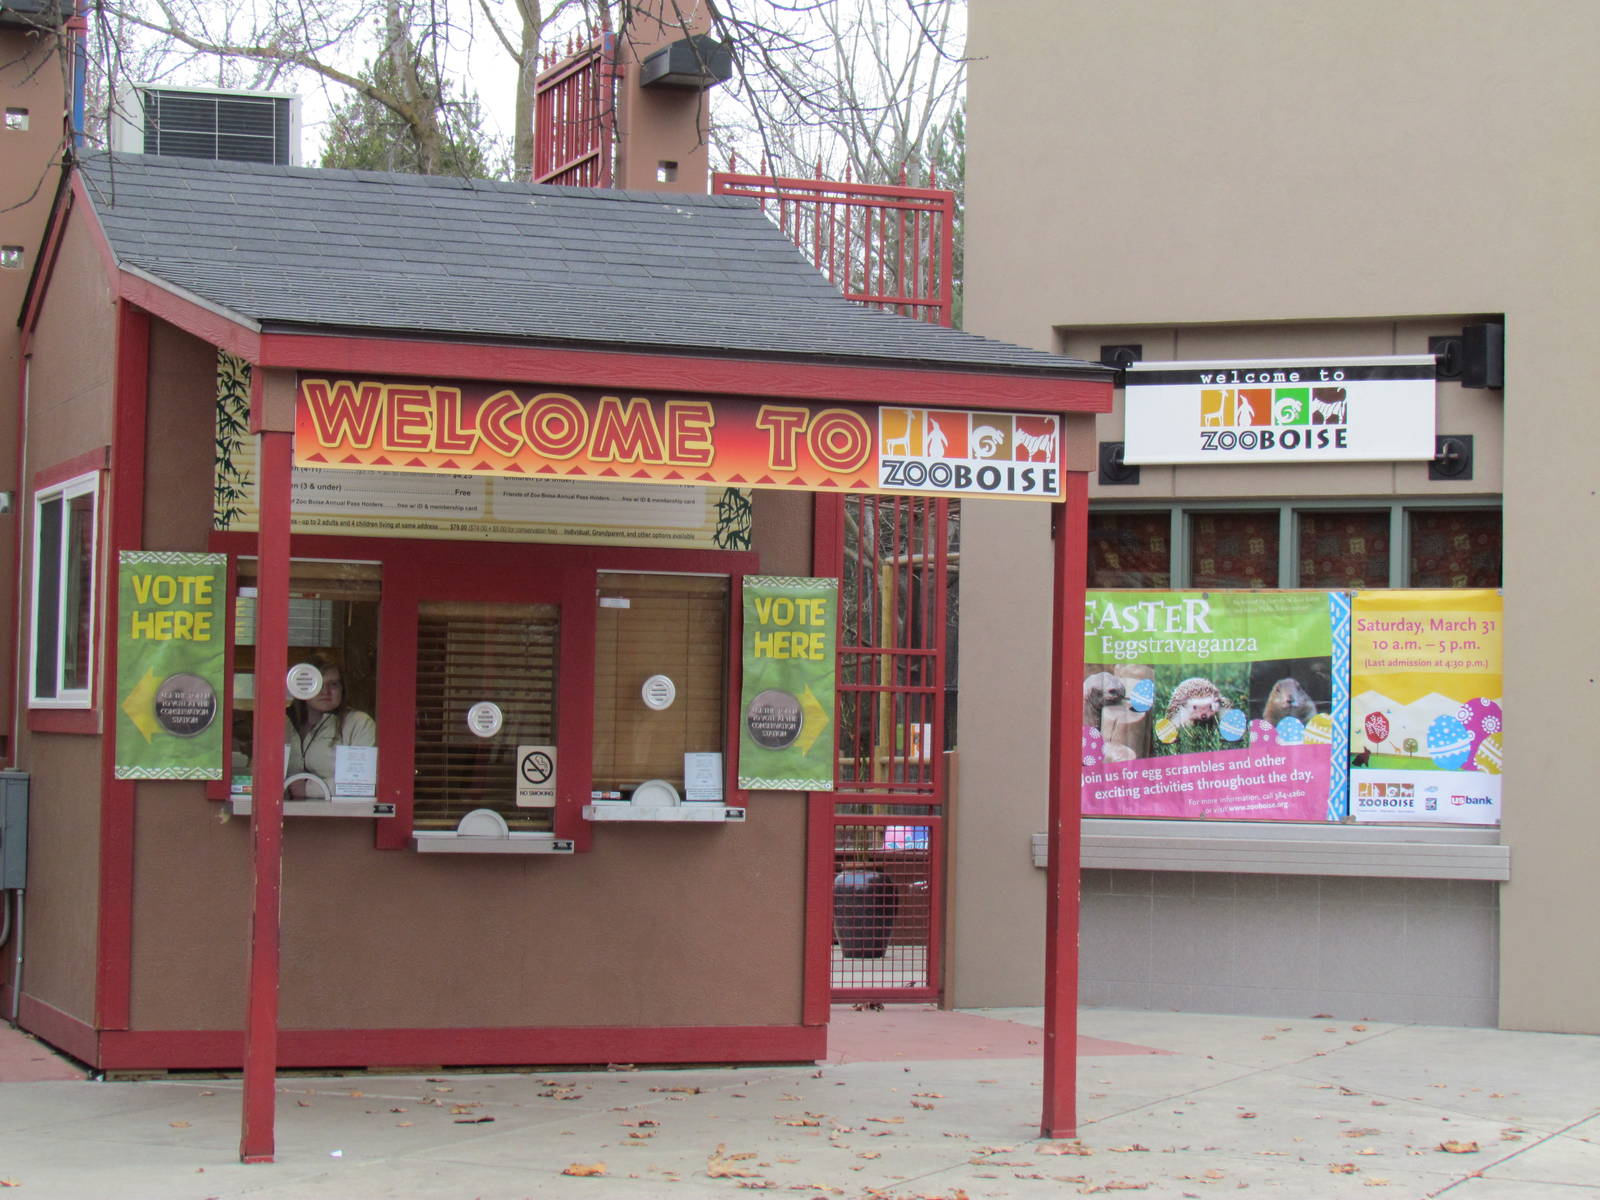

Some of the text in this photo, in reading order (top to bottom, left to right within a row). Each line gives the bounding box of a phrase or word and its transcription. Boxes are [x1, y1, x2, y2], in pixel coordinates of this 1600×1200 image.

[1200, 368, 1345, 385] welcome to
[301, 378, 871, 474] WELCOME TO
[317, 483, 342, 492] under)
[455, 488, 472, 497] Free
[355, 520, 379, 529] children
[131, 574, 215, 606] VOTE
[754, 597, 827, 626] VOTE
[131, 610, 214, 641] HERE
[1357, 617, 1496, 635] Saturday, March 31
[753, 631, 826, 661] HERE
[1102, 636, 1258, 659] Eggstravaganza
[1372, 640, 1388, 650] 10
[1392, 640, 1422, 650] a.m.
[1439, 640, 1446, 653] 5
[1450, 640, 1481, 653] p.m.
[1364, 659, 1385, 669] (Last
[1387, 658, 1432, 668] admission
[1435, 659, 1444, 667] at
[1466, 659, 1489, 670] p.m.)
[1081, 754, 1286, 787] Join us for egg scrambles and other
[1095, 768, 1314, 800] exciting activities throughout the day.
